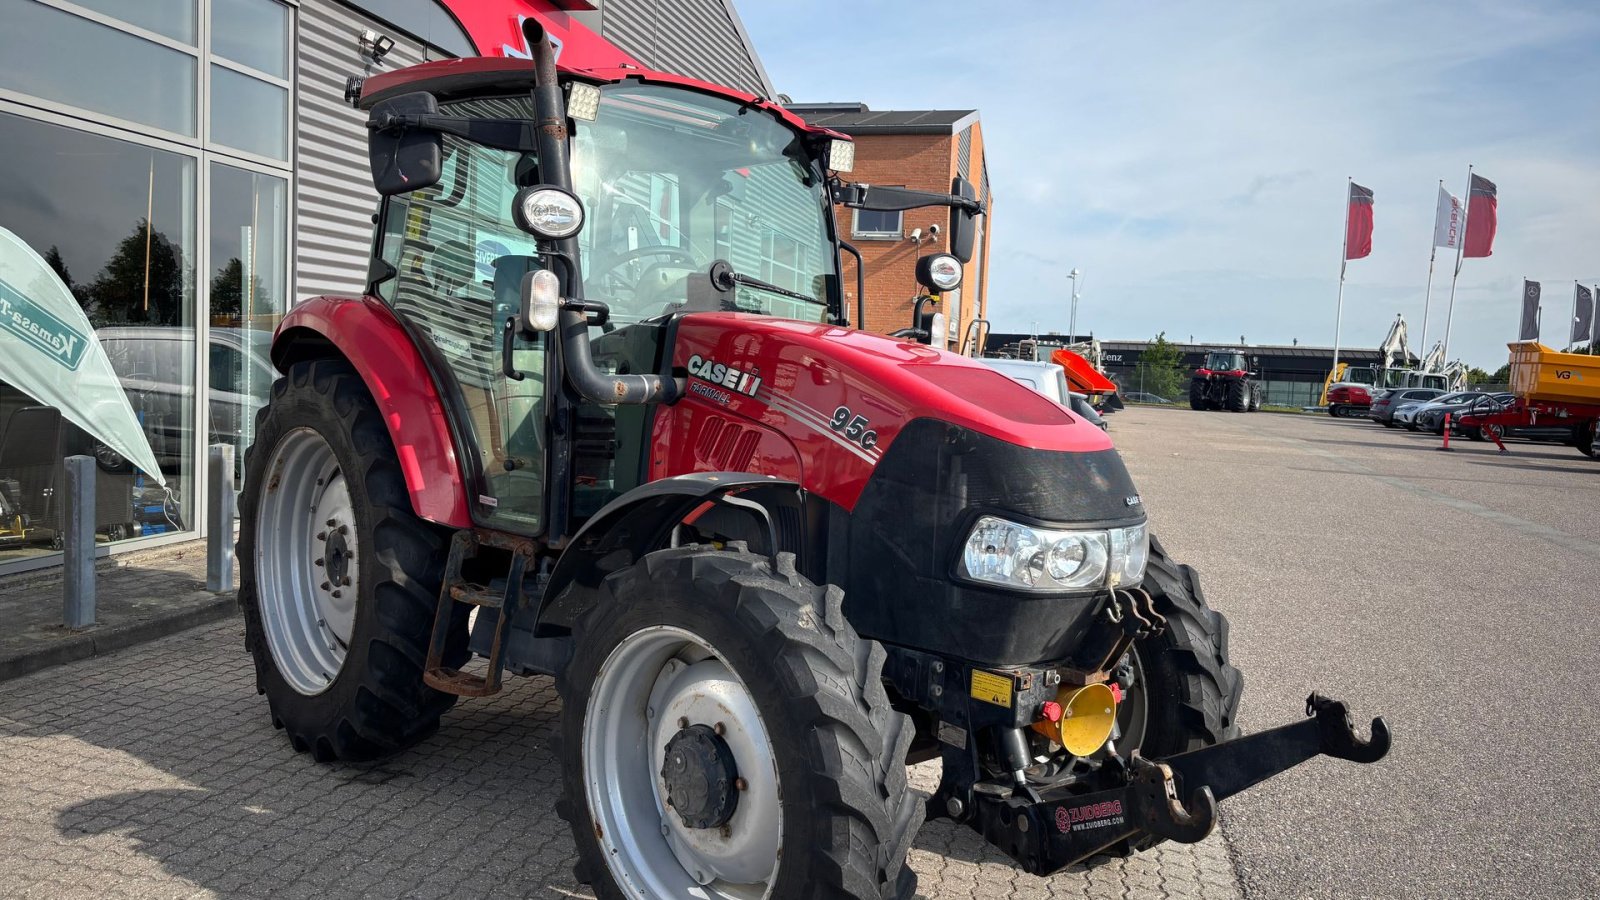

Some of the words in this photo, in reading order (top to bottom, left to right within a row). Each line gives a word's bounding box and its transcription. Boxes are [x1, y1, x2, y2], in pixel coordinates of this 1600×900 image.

[687, 354, 741, 390] CASE
[1555, 369, 1571, 380] VG
[689, 381, 731, 404] FARMALL
[1069, 800, 1123, 823] ZUIDBERG
